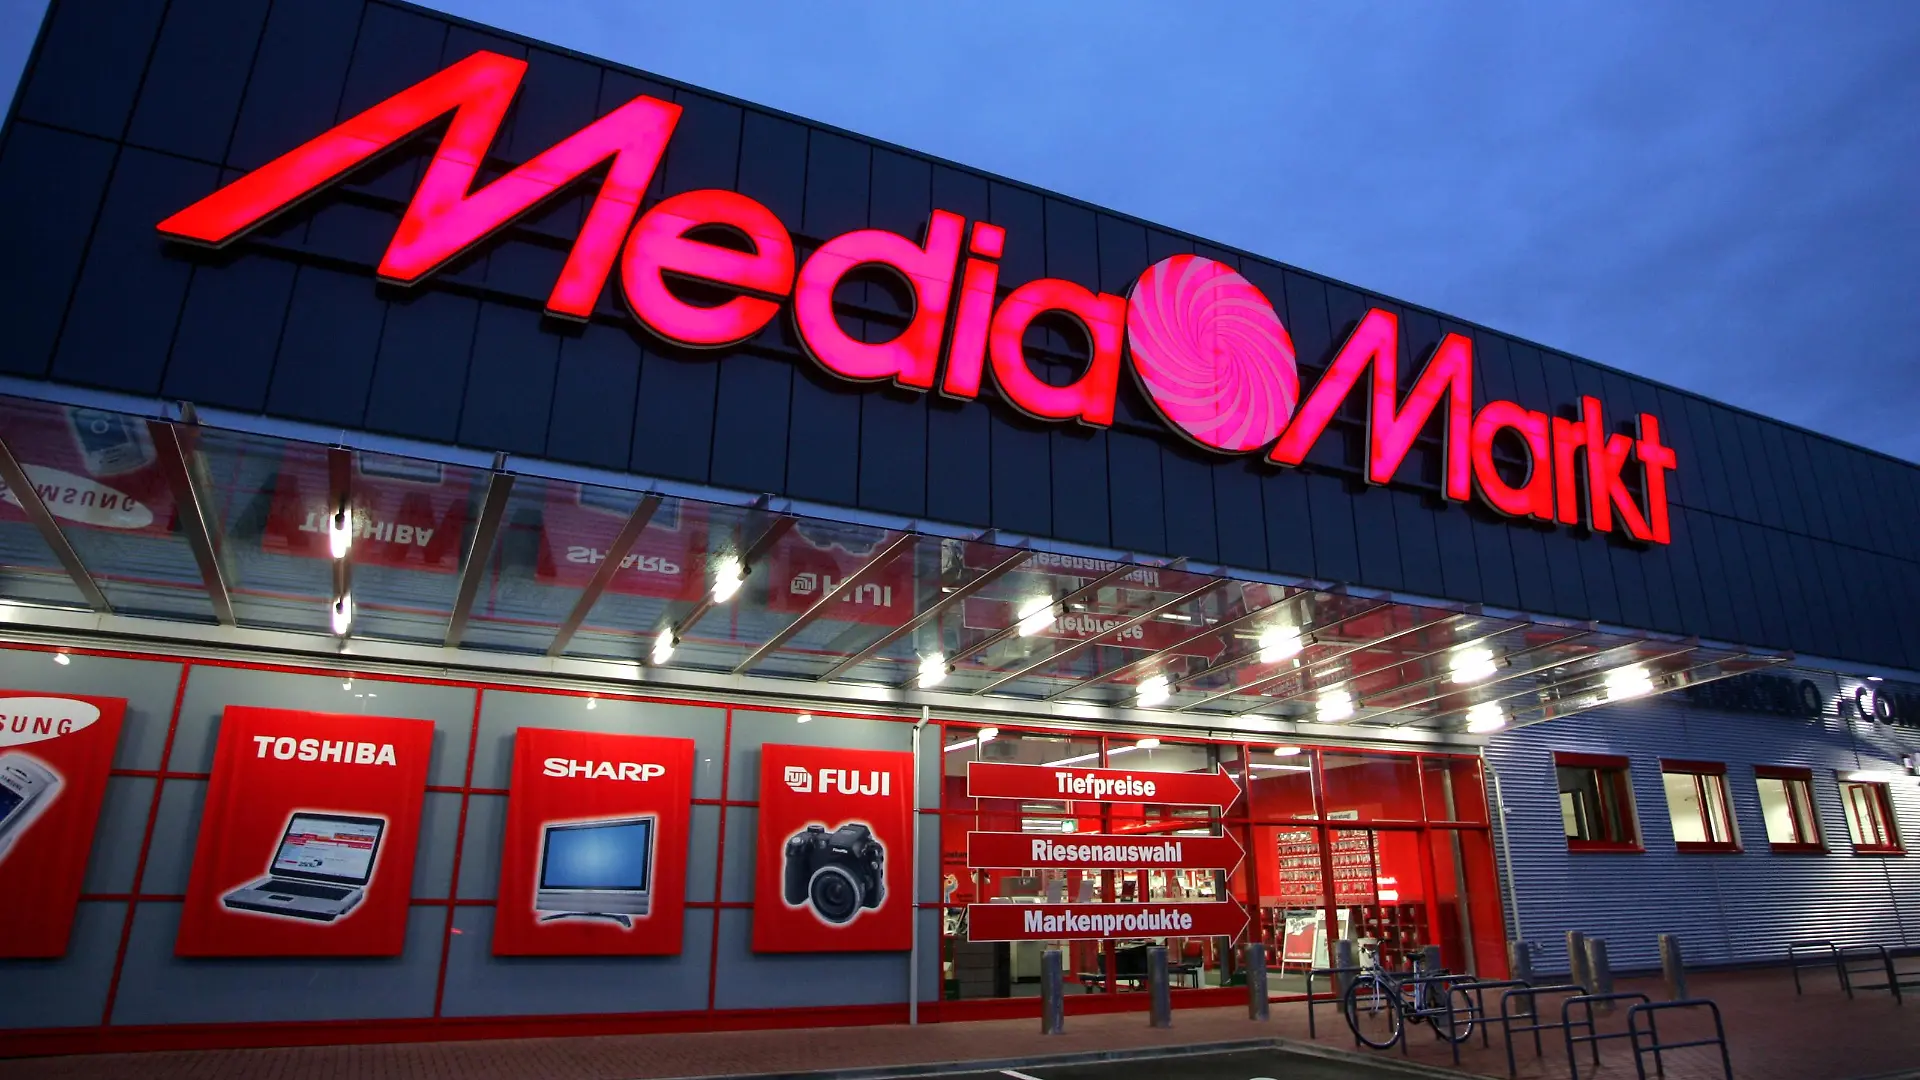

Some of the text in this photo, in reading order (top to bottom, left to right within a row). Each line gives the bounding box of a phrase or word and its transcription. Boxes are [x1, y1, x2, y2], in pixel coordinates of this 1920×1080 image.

[157, 50, 1677, 545] Media Markt
[253, 735, 397, 766] TOSHIBA
[542, 757, 666, 782] SHARP
[818, 768, 890, 796] FUJI
[1055, 771, 1156, 799] Tiefpreise
[1031, 839, 1182, 863] Riesenauswahl
[1024, 908, 1193, 936] Markenprodukte
